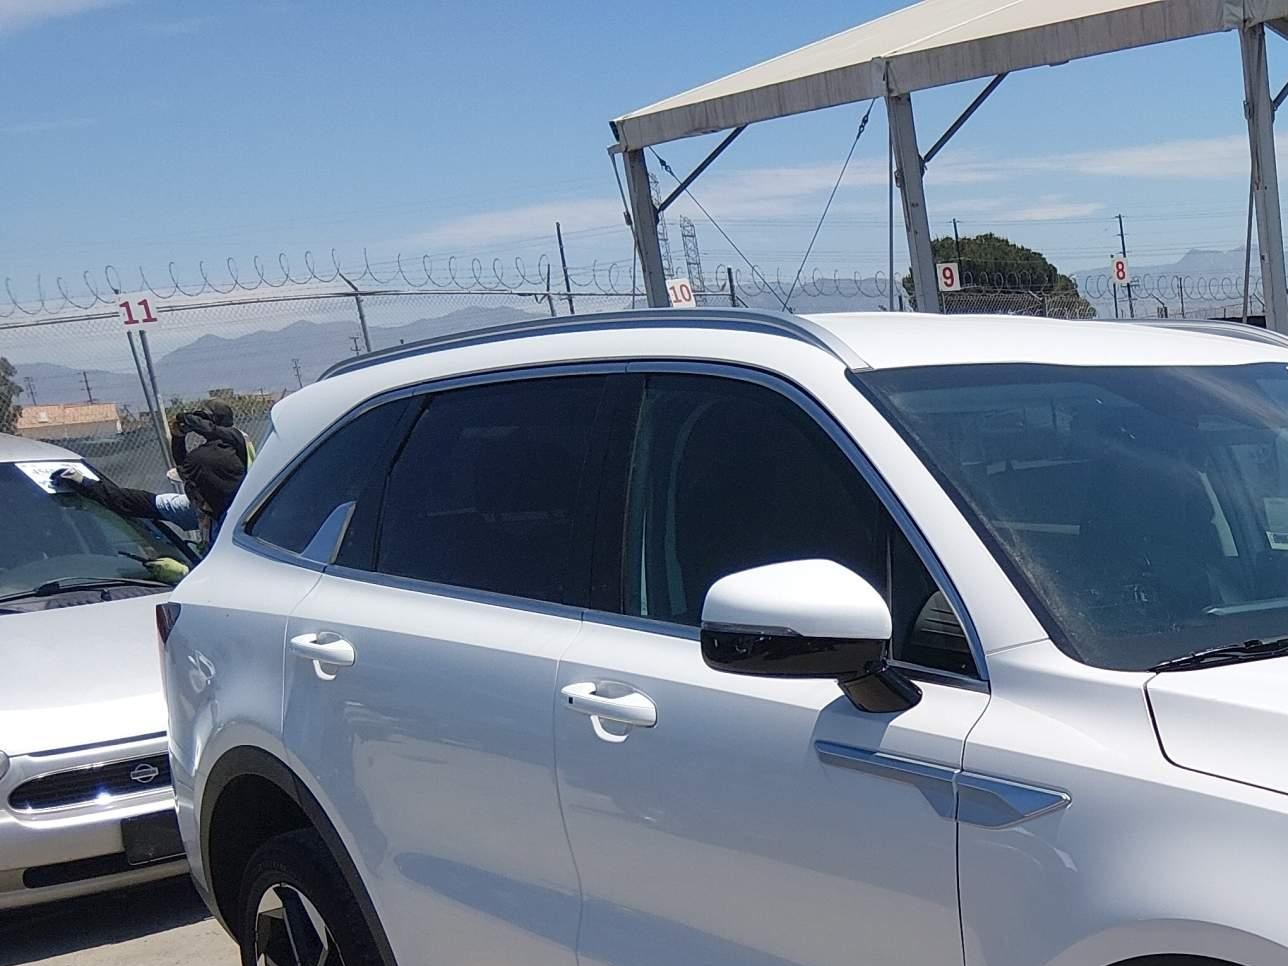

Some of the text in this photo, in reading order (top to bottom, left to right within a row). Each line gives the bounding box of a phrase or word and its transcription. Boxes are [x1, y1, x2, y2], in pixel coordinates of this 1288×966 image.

[942, 266, 955, 288] 9
[1115, 261, 1126, 280] 8
[669, 283, 692, 304] 10
[119, 298, 158, 325] 11
